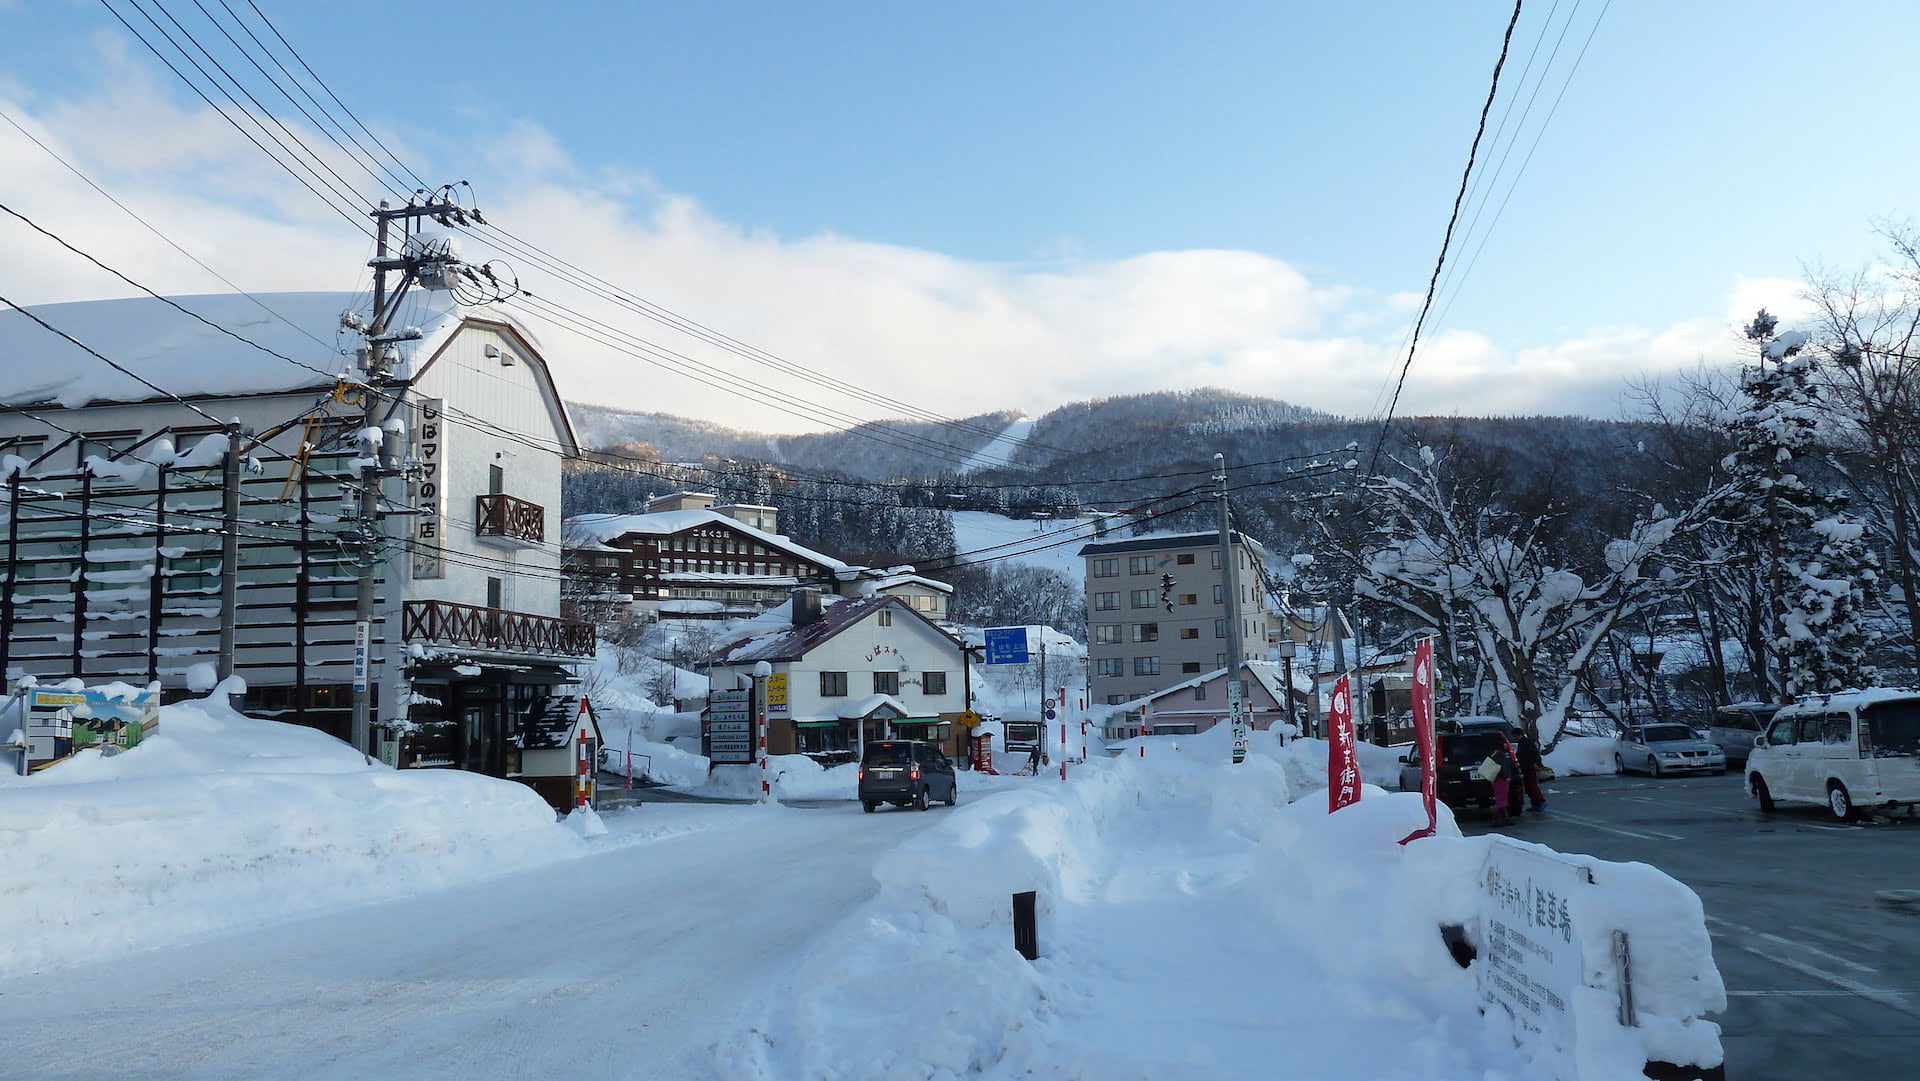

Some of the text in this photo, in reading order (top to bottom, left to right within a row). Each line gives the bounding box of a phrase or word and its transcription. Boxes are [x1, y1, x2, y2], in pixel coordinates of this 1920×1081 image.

[692, 529, 730, 538] こまくさ荘
[865, 644, 905, 663] しばスキー
[1231, 701, 1244, 738] ろばた
